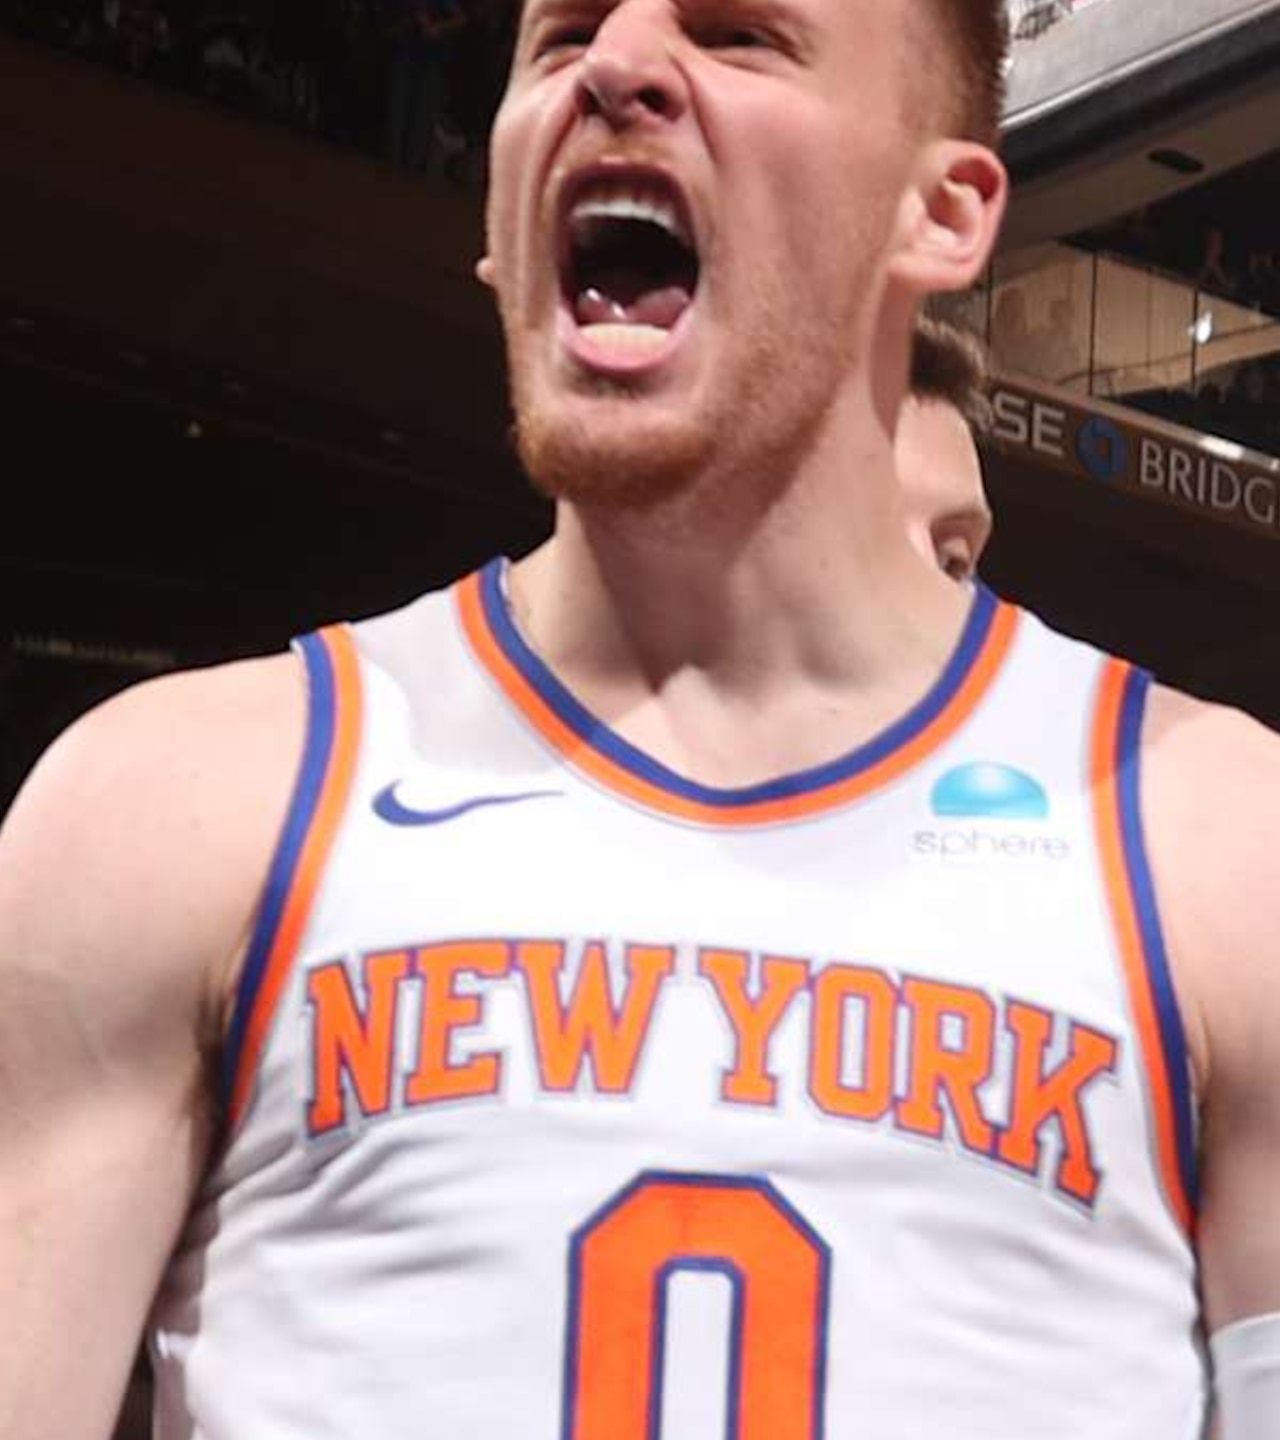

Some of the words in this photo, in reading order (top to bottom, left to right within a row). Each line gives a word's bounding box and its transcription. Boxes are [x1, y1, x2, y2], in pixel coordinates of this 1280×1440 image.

[913, 828, 1071, 863] sphere
[306, 936, 676, 1139] NEW
[700, 945, 1120, 1213] YORK
